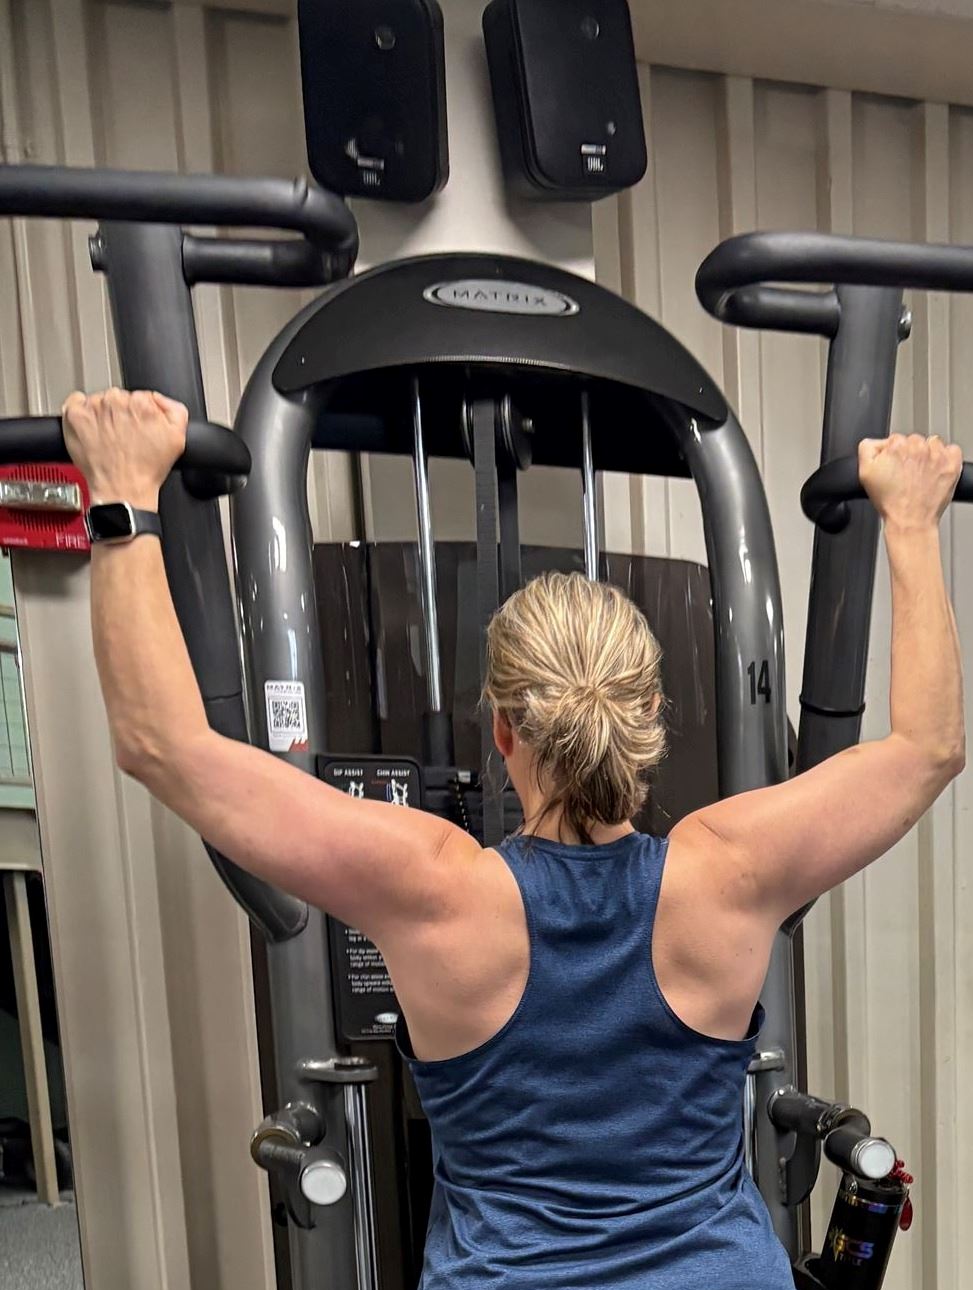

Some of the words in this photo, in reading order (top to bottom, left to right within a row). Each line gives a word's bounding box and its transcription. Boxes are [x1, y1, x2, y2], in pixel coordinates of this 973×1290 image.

[453, 289, 547, 306] MATRIX
[55, 531, 87, 549] FIRE
[747, 660, 771, 705] 14
